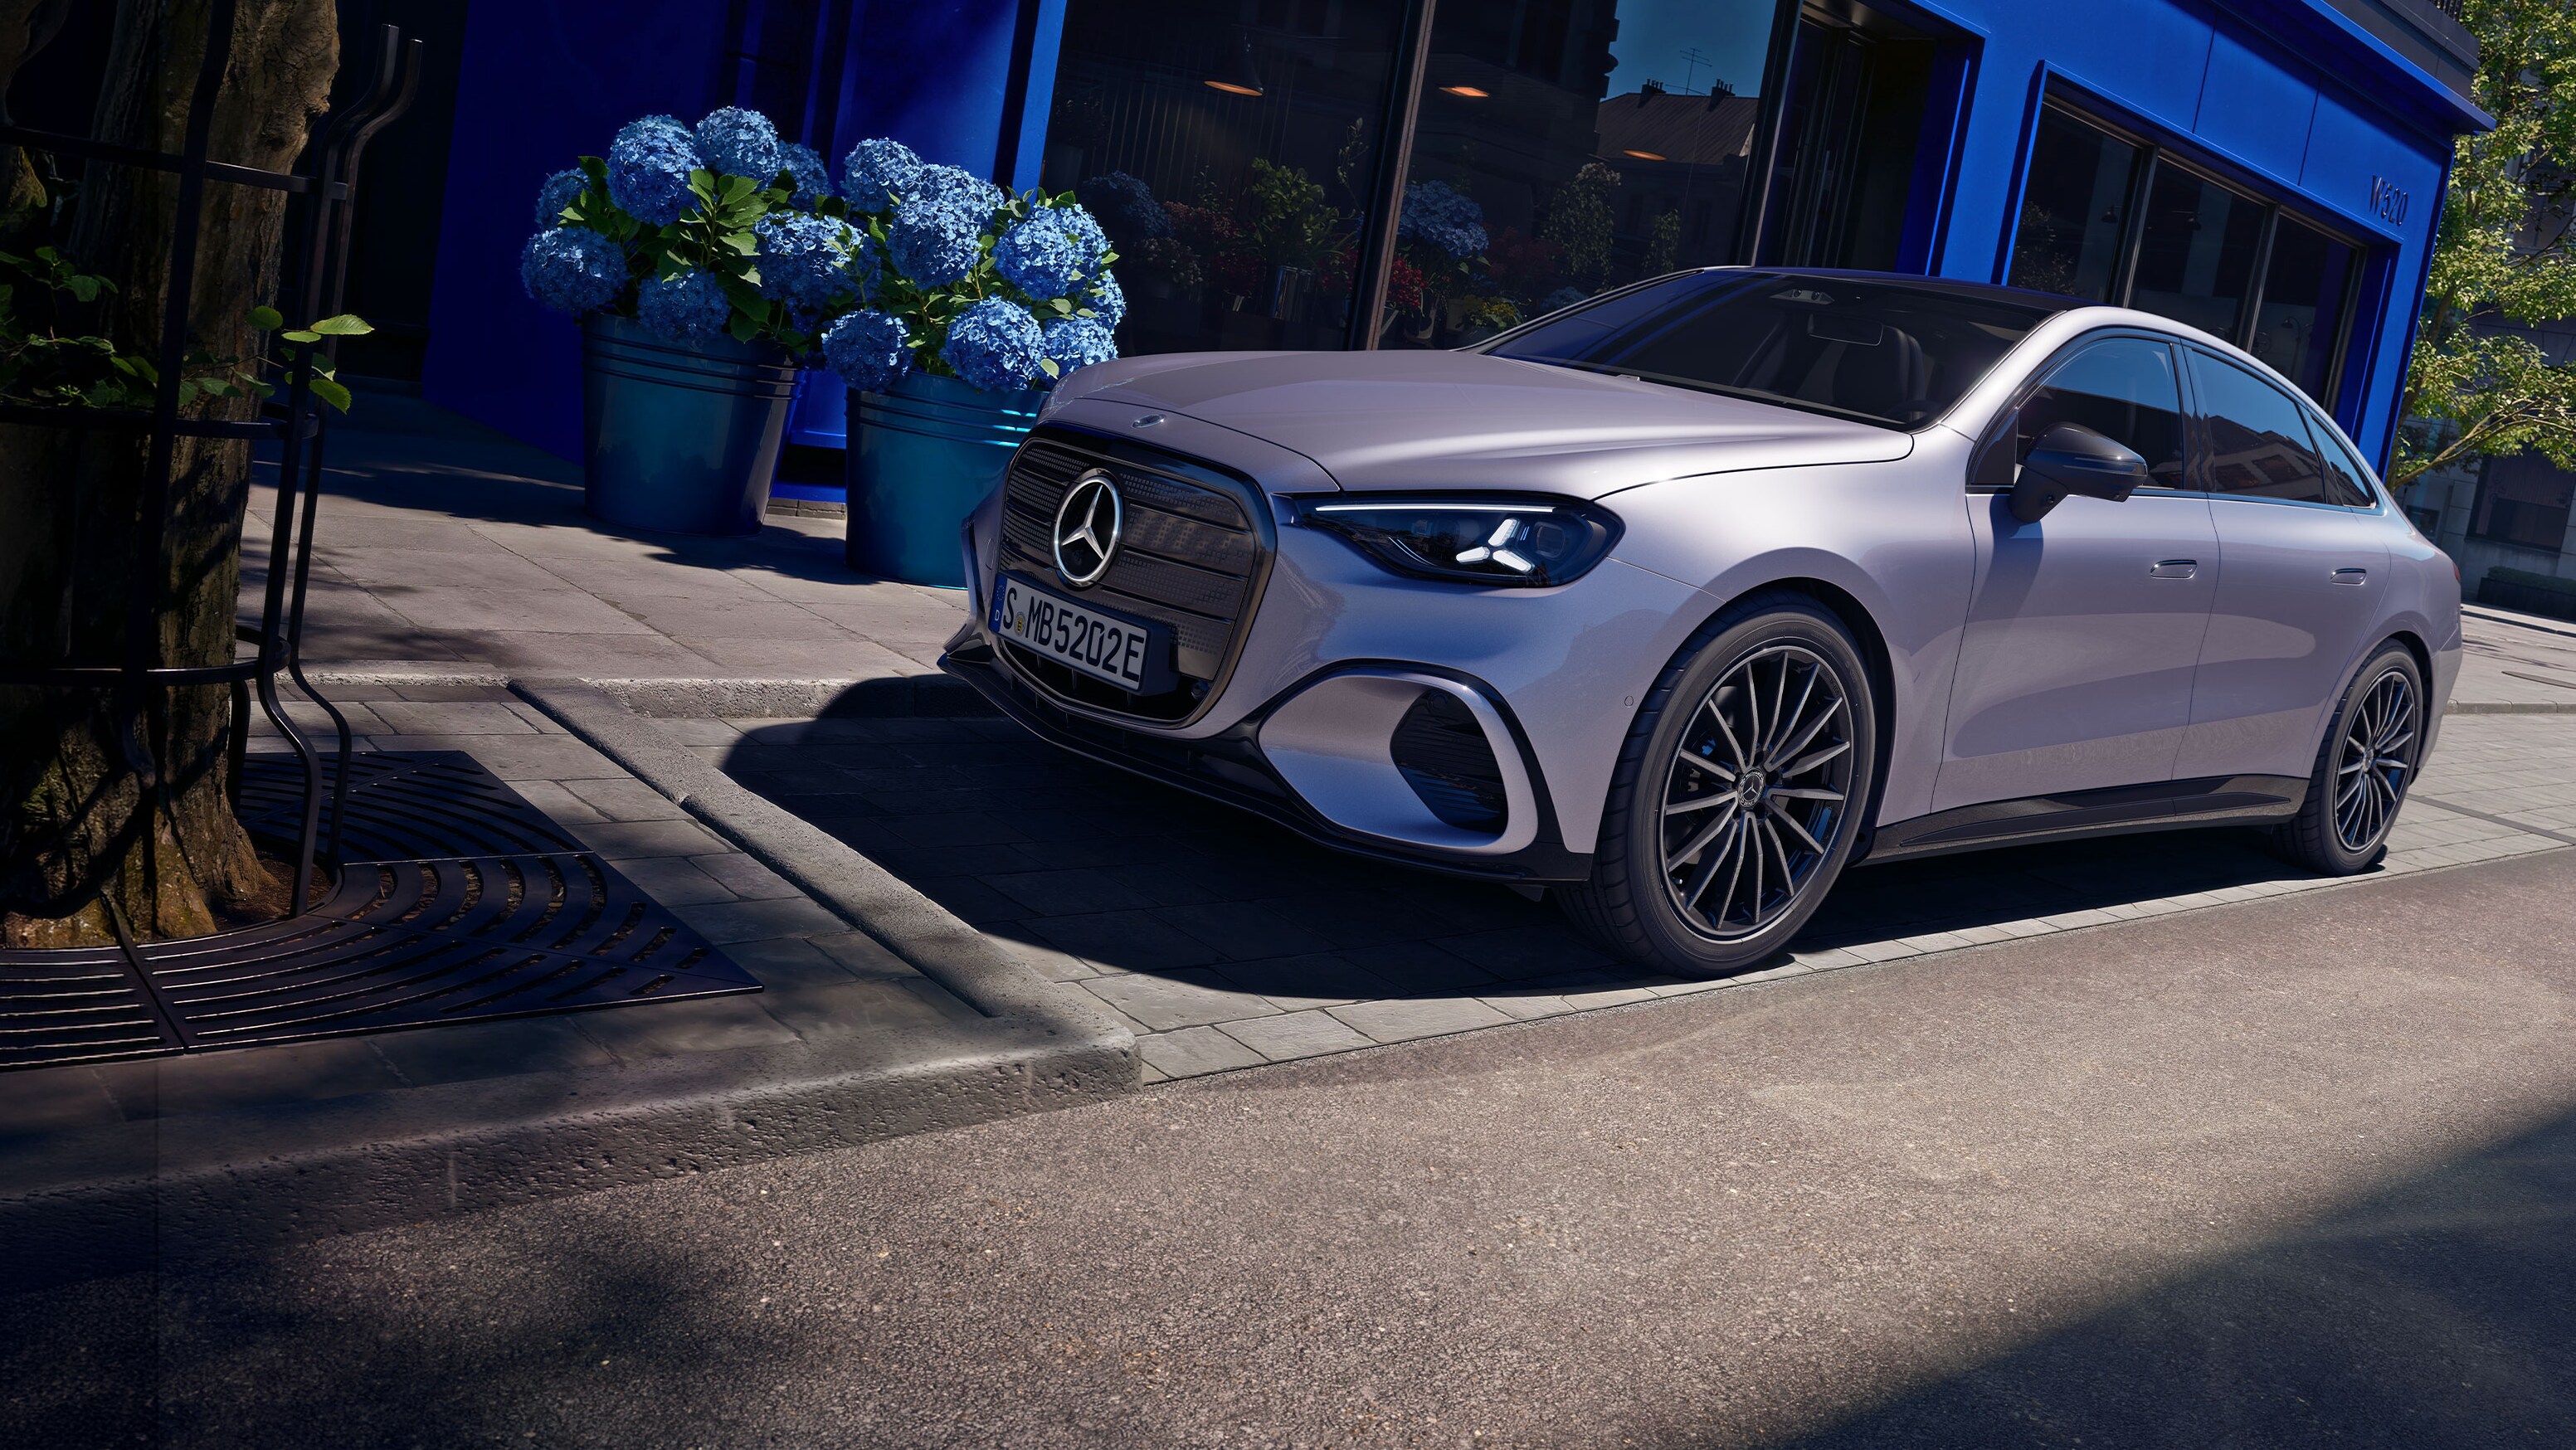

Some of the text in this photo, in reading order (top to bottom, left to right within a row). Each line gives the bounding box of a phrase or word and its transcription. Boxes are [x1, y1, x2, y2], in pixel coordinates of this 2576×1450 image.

[2369, 174, 2408, 226] W520
[994, 609, 1000, 621] D
[1002, 587, 1017, 630] S
